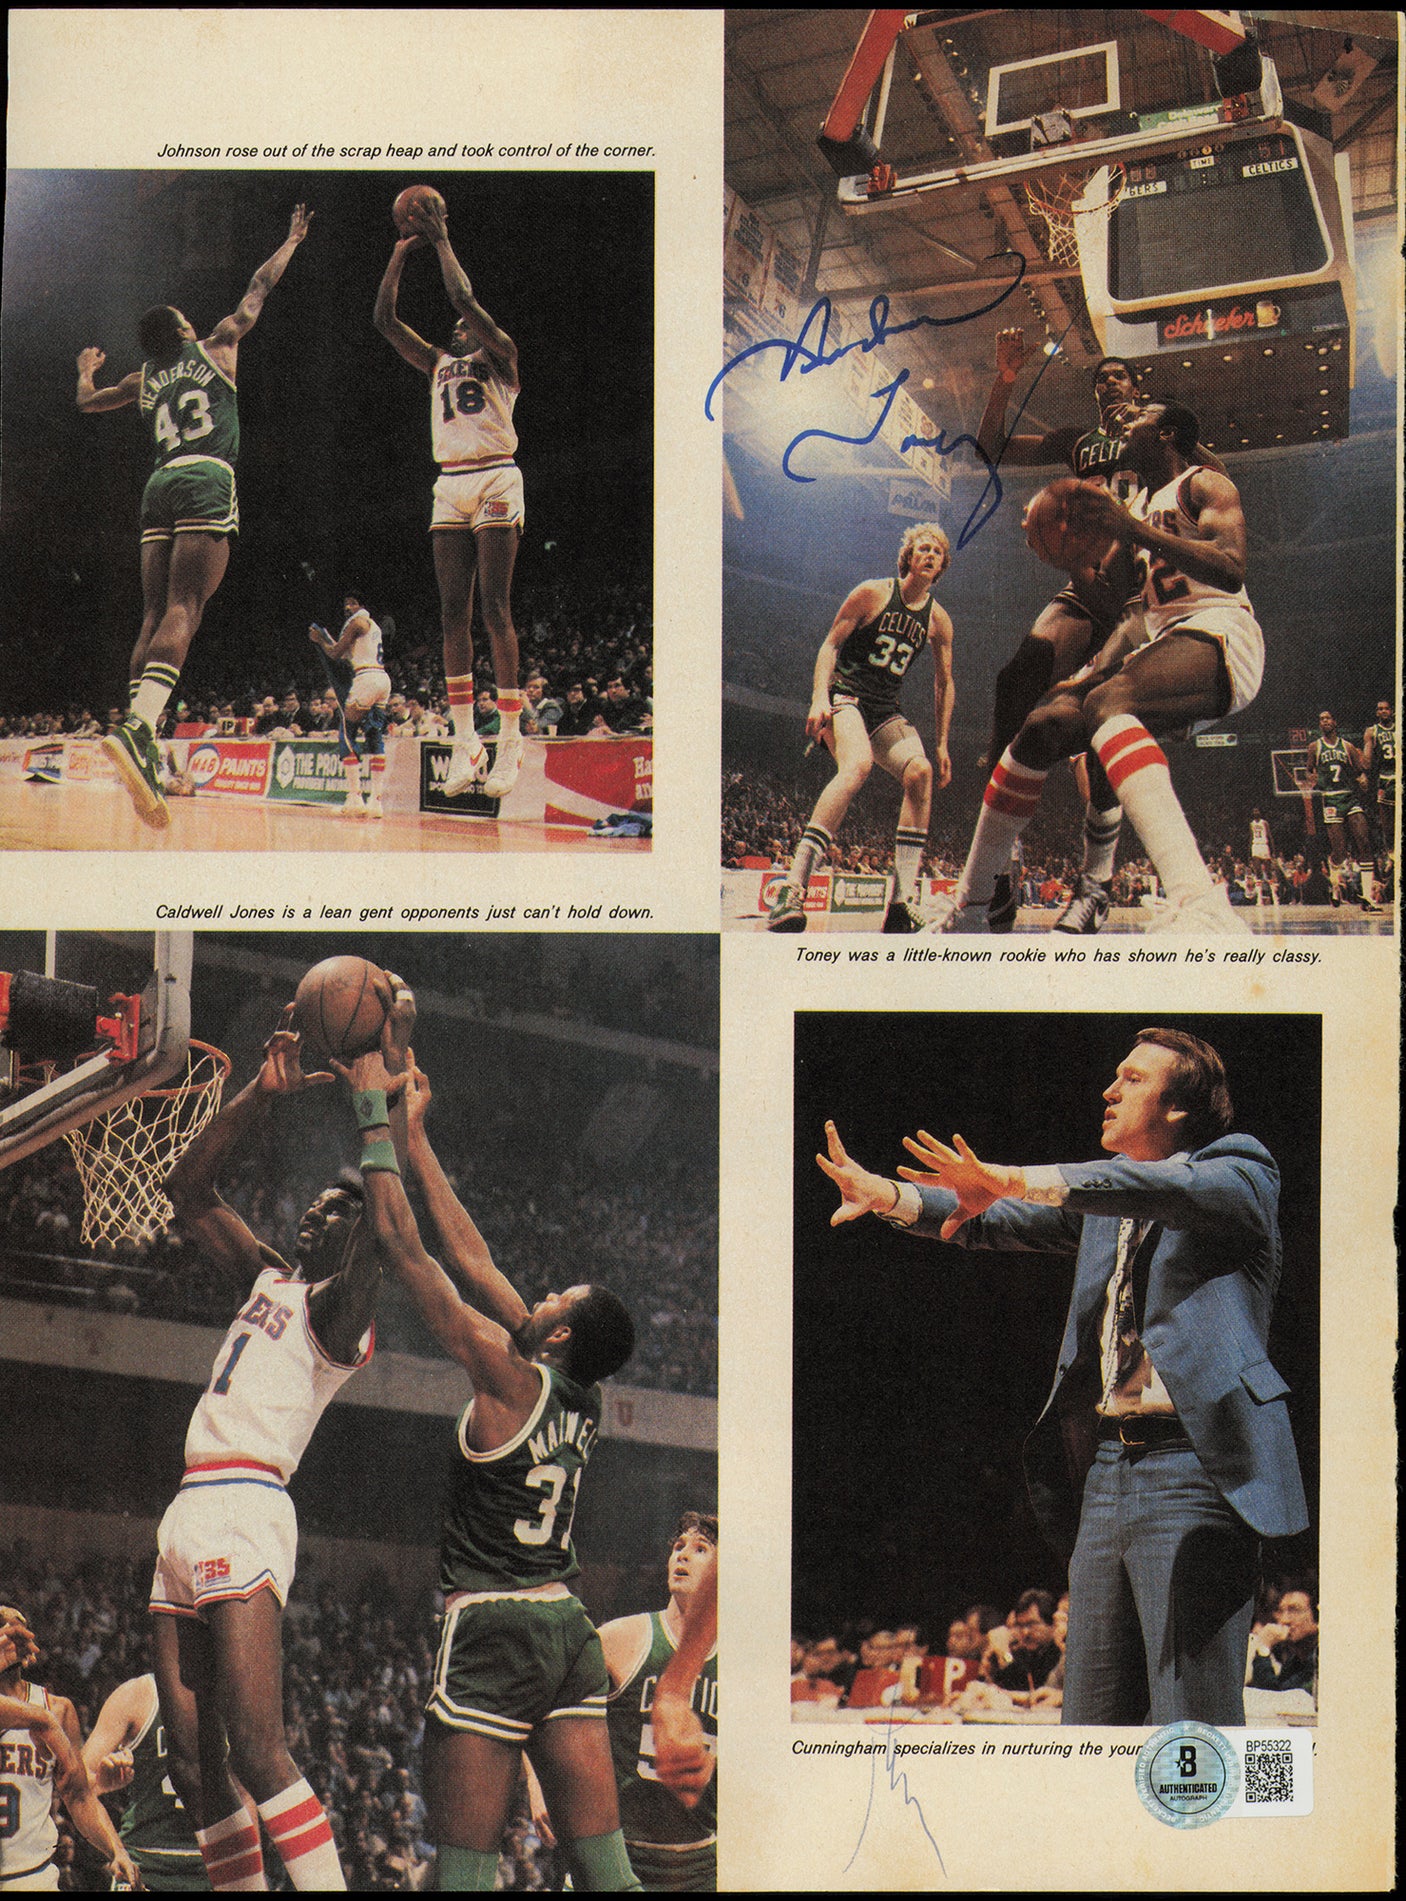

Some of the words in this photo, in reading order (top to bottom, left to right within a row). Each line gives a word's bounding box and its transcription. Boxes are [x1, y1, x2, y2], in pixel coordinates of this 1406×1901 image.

[157, 143, 221, 158] Johnson
[225, 147, 259, 158] rose
[263, 145, 288, 158] out
[292, 143, 309, 158] of
[311, 143, 335, 158] the
[339, 146, 382, 160] scrap
[385, 143, 424, 160] heap
[427, 143, 458, 158] and
[461, 143, 494, 158] took
[498, 143, 553, 158] control
[555, 143, 573, 158] of
[575, 143, 599, 158] the
[603, 146, 655, 158] corner.
[1249, 158, 1293, 174] CELTICS
[141, 359, 217, 411] HENDERSON
[440, 380, 486, 424] 18
[155, 389, 215, 452] 43
[1079, 437, 1124, 472] CELTI
[878, 611, 927, 649] CELTICS
[868, 634, 915, 677] 33
[1321, 749, 1349, 764] CELTICS
[1382, 744, 1395, 760] 3
[219, 758, 267, 778] PAINTS
[293, 753, 314, 776] THE
[1330, 764, 1341, 783] 7
[156, 904, 224, 919] Caldwell
[229, 904, 275, 919] Jones
[282, 904, 296, 919] is
[302, 908, 312, 919] a
[319, 904, 352, 919] lean
[359, 906, 394, 922] gent
[400, 906, 480, 922] opponents
[485, 904, 516, 922] just
[523, 905, 561, 919] can't
[567, 904, 603, 919] hold
[608, 905, 654, 919] down.
[797, 947, 841, 965] Toney
[848, 951, 879, 962] was
[886, 951, 896, 962] a
[903, 947, 992, 962] little-known
[999, 947, 1047, 962] rookie
[1054, 948, 1086, 962] who
[1093, 948, 1121, 962] has
[1127, 948, 1178, 963] shown
[1184, 948, 1216, 963] he's
[1223, 948, 1266, 965] really
[1272, 948, 1322, 966] classy.
[527, 1410, 598, 1465] MAWEL
[204, 1557, 231, 1580] 35
[640, 1674, 718, 1720] CTIC
[792, 1740, 887, 1758] Cunningham
[893, 1740, 976, 1758] specializes
[981, 1741, 996, 1755] in
[1001, 1741, 1073, 1759] nurturing
[1079, 1741, 1103, 1756] the
[1246, 1739, 1292, 1752] BP55322
[1179, 1745, 1197, 1778] B
[1158, 1782, 1218, 1795] AUTHENTICATED
